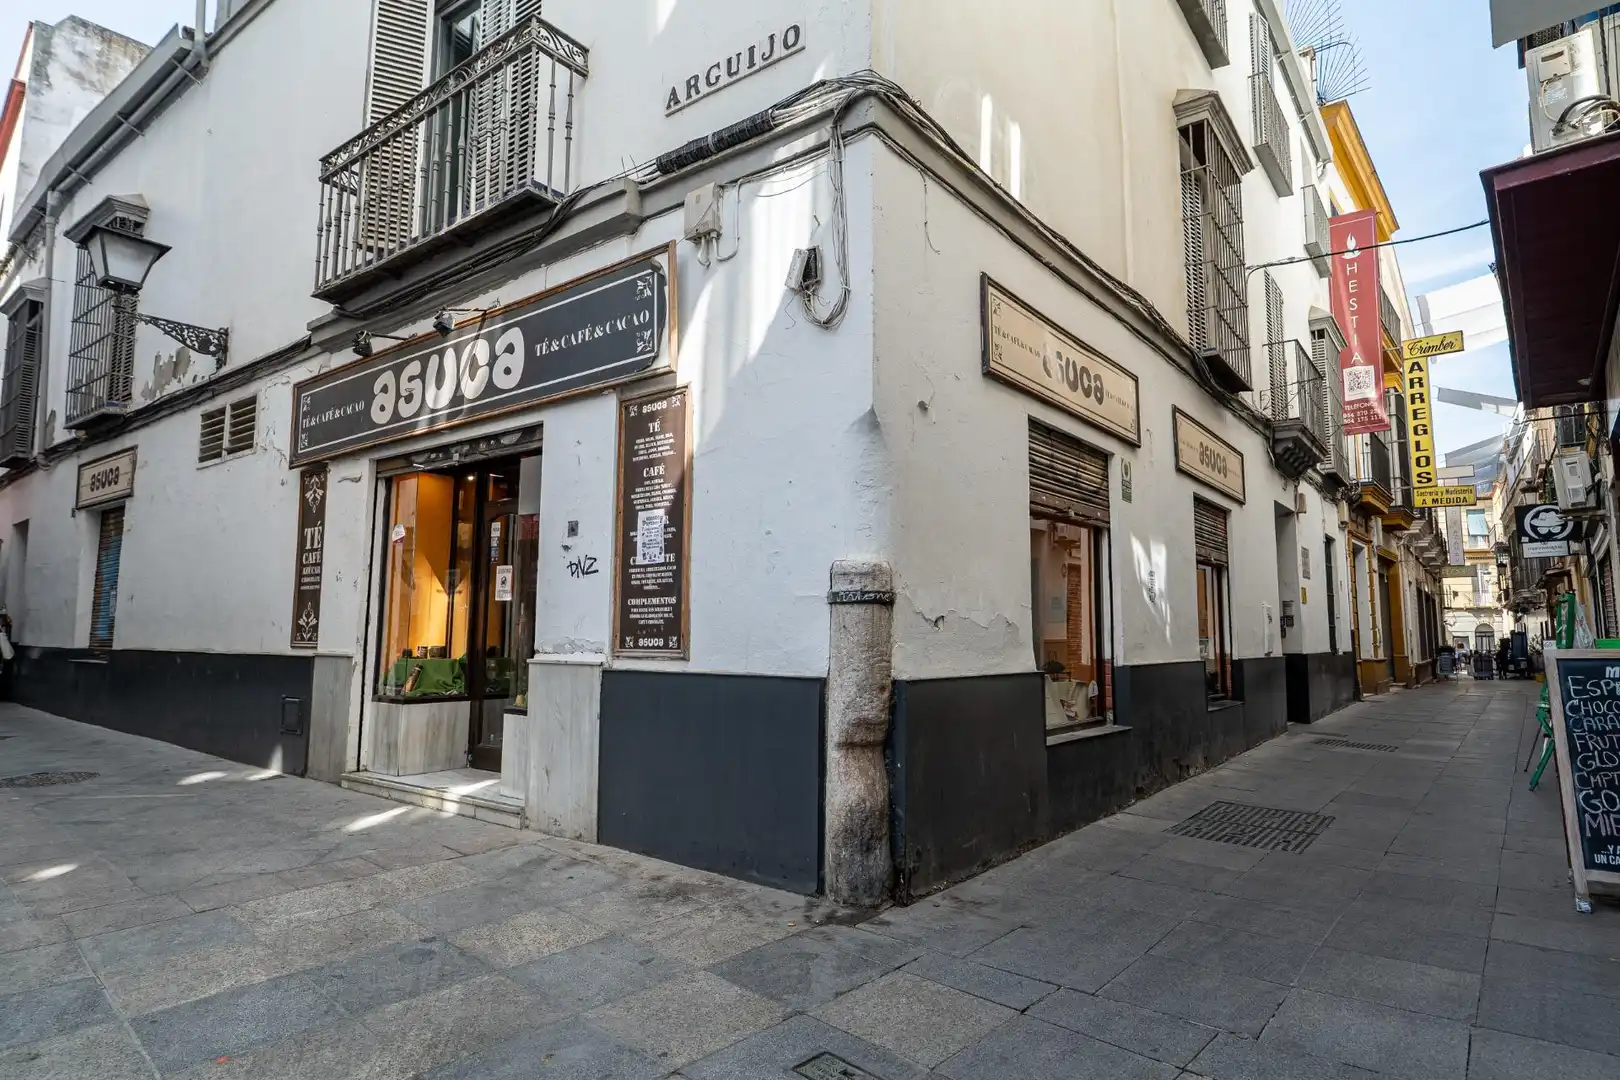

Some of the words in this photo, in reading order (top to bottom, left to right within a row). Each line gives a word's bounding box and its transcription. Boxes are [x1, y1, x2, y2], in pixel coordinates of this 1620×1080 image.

[665, 24, 801, 110] ARGUIJO
[1346, 263, 1364, 365] HESTIA
[370, 326, 525, 425] asuca
[648, 416, 661, 433] TÉ
[1408, 361, 1433, 484] ARREGLOS
[643, 463, 665, 478] CAFÉ
[1431, 497, 1468, 505] MEDIDA
[304, 520, 323, 550] TÉ
[302, 549, 321, 565] CAFÉ
[627, 596, 677, 606] COMPLEMENTOS
[1577, 750, 1620, 771] GLO
